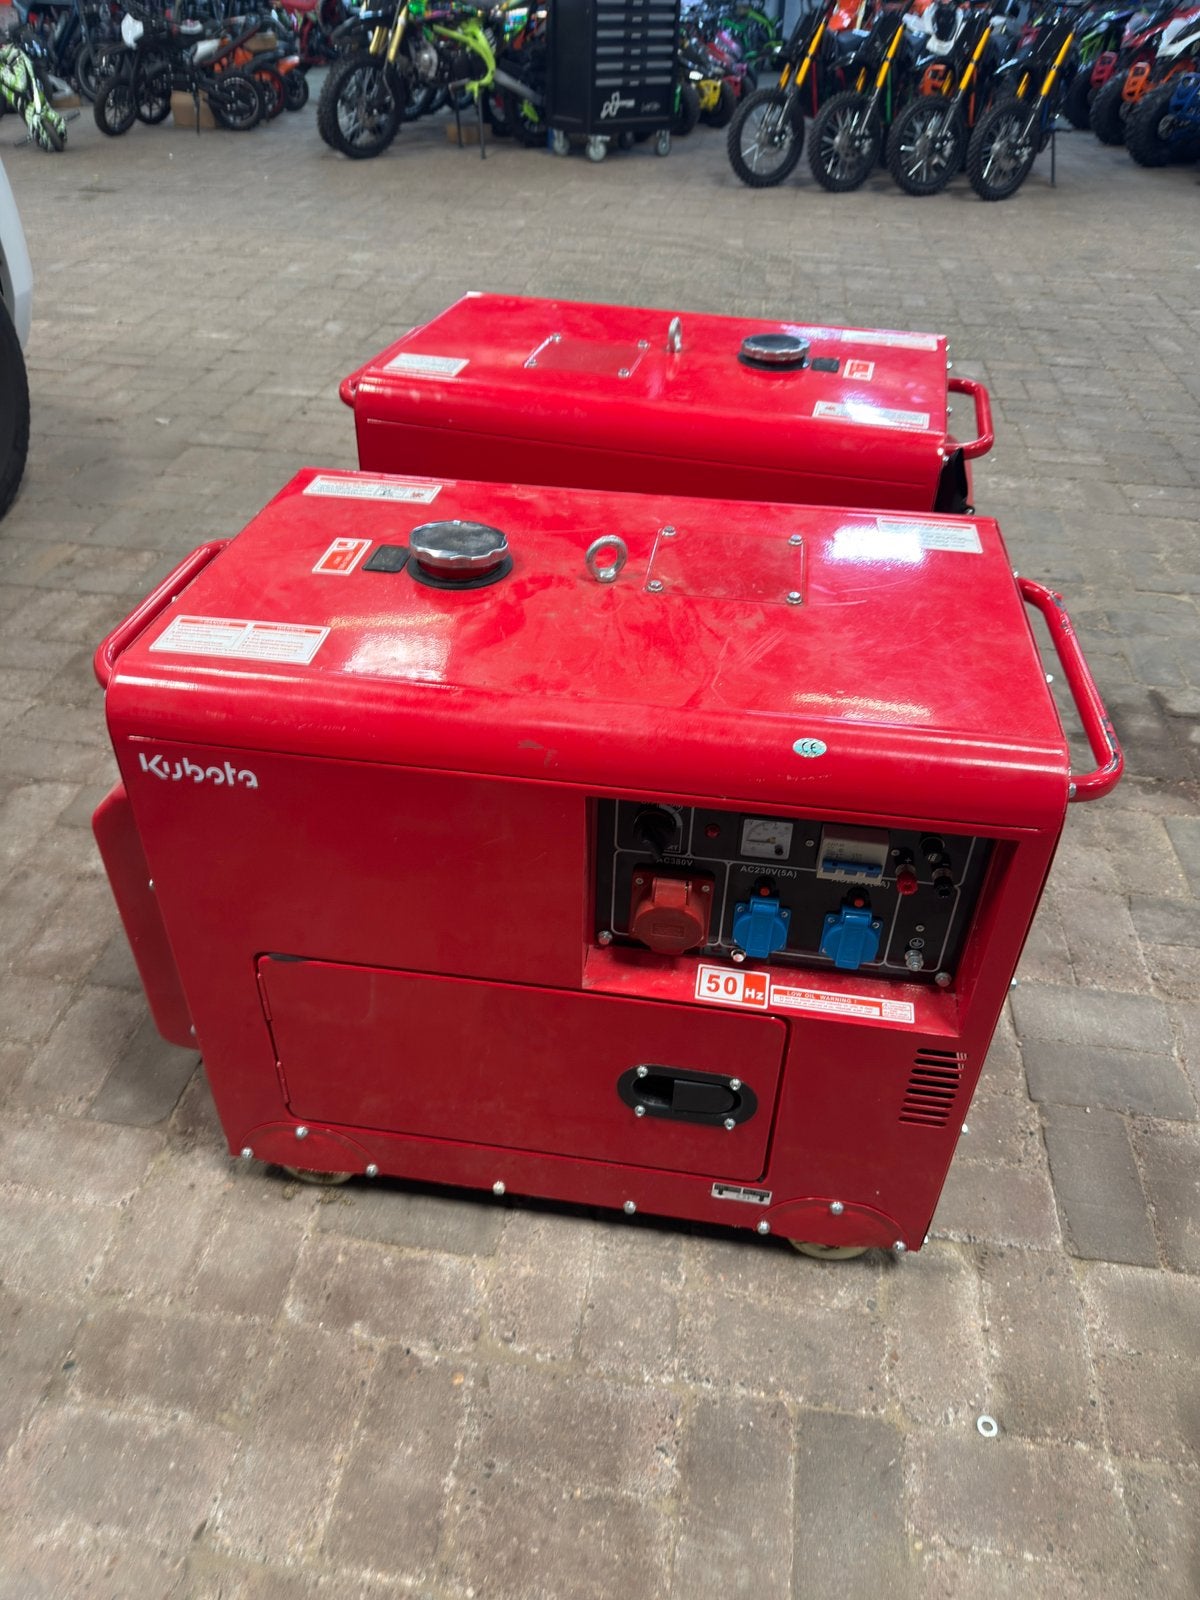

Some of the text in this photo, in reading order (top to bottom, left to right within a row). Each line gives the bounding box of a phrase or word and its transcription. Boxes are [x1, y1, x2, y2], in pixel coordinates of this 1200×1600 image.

[138, 752, 259, 789] Kubota
[740, 865, 798, 879] AC230V(5A)
[706, 973, 764, 1001] 50 Hz
[786, 990, 803, 998] LOW
[820, 994, 852, 1004] WARNING
